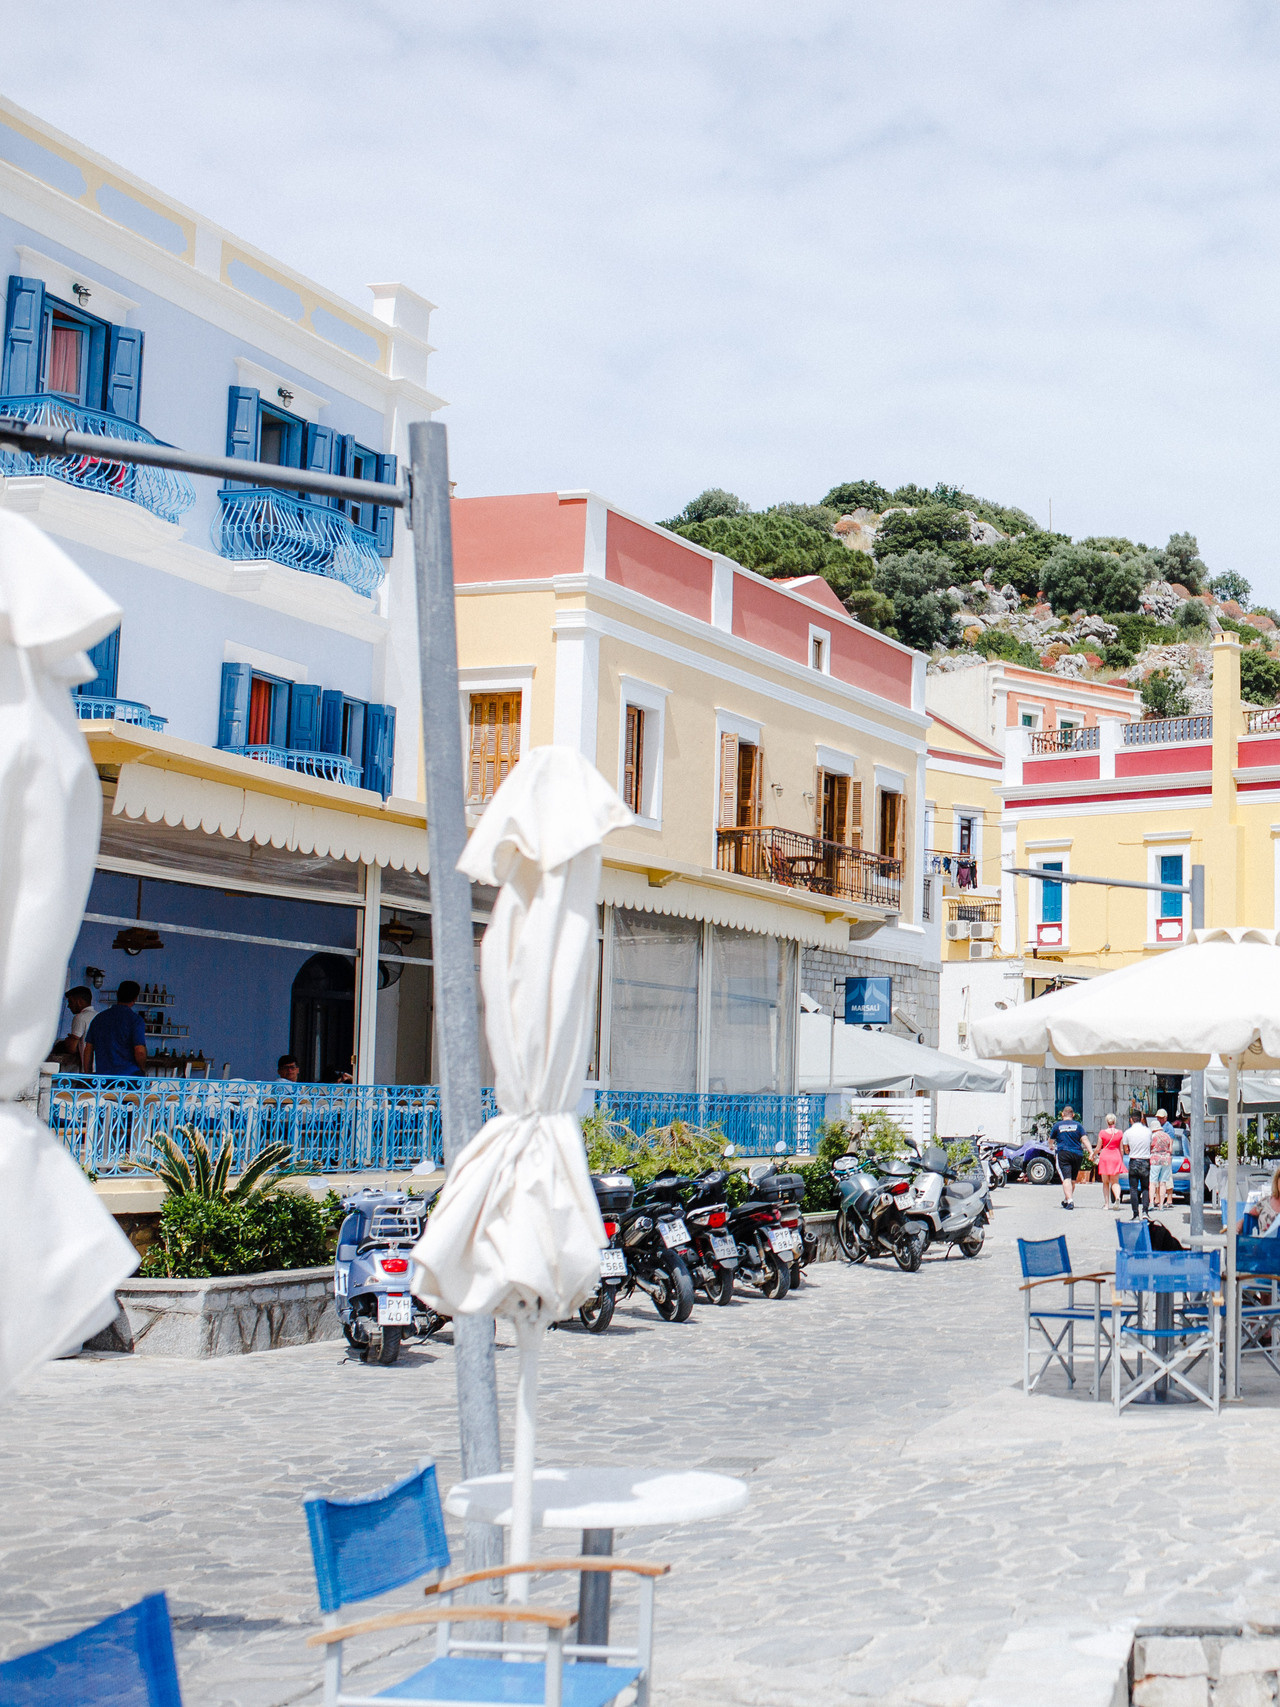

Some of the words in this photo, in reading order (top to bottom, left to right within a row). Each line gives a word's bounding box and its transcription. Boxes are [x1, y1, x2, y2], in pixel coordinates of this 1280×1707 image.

[671, 1231, 687, 1243] 427
[720, 1246, 737, 1256] 795
[387, 1299, 410, 1309] PYH
[387, 1312, 410, 1322] 401
